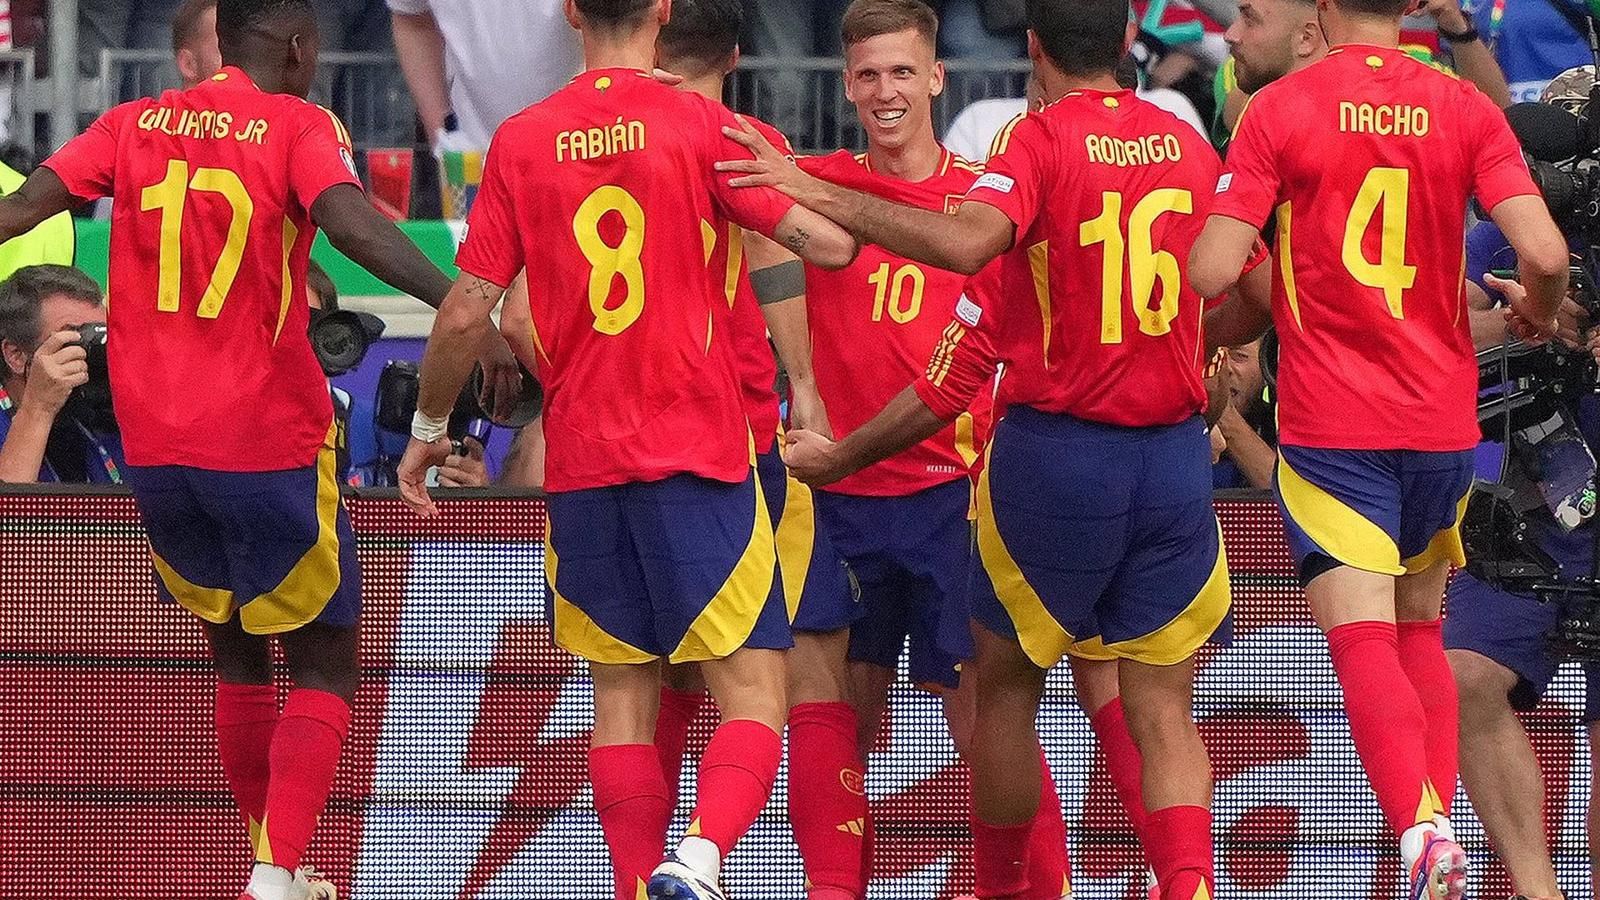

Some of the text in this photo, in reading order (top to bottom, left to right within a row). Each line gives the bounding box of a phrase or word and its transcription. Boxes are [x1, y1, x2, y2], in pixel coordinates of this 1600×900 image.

[555, 115, 646, 163] FABIÁN
[1085, 133, 1182, 167] RODRIGO
[1339, 101, 1430, 137] NACHO
[140, 159, 254, 320] 17
[572, 184, 646, 336] 8
[1079, 187, 1194, 345] 16
[1341, 167, 1417, 320] 4
[867, 262, 926, 325] 10
